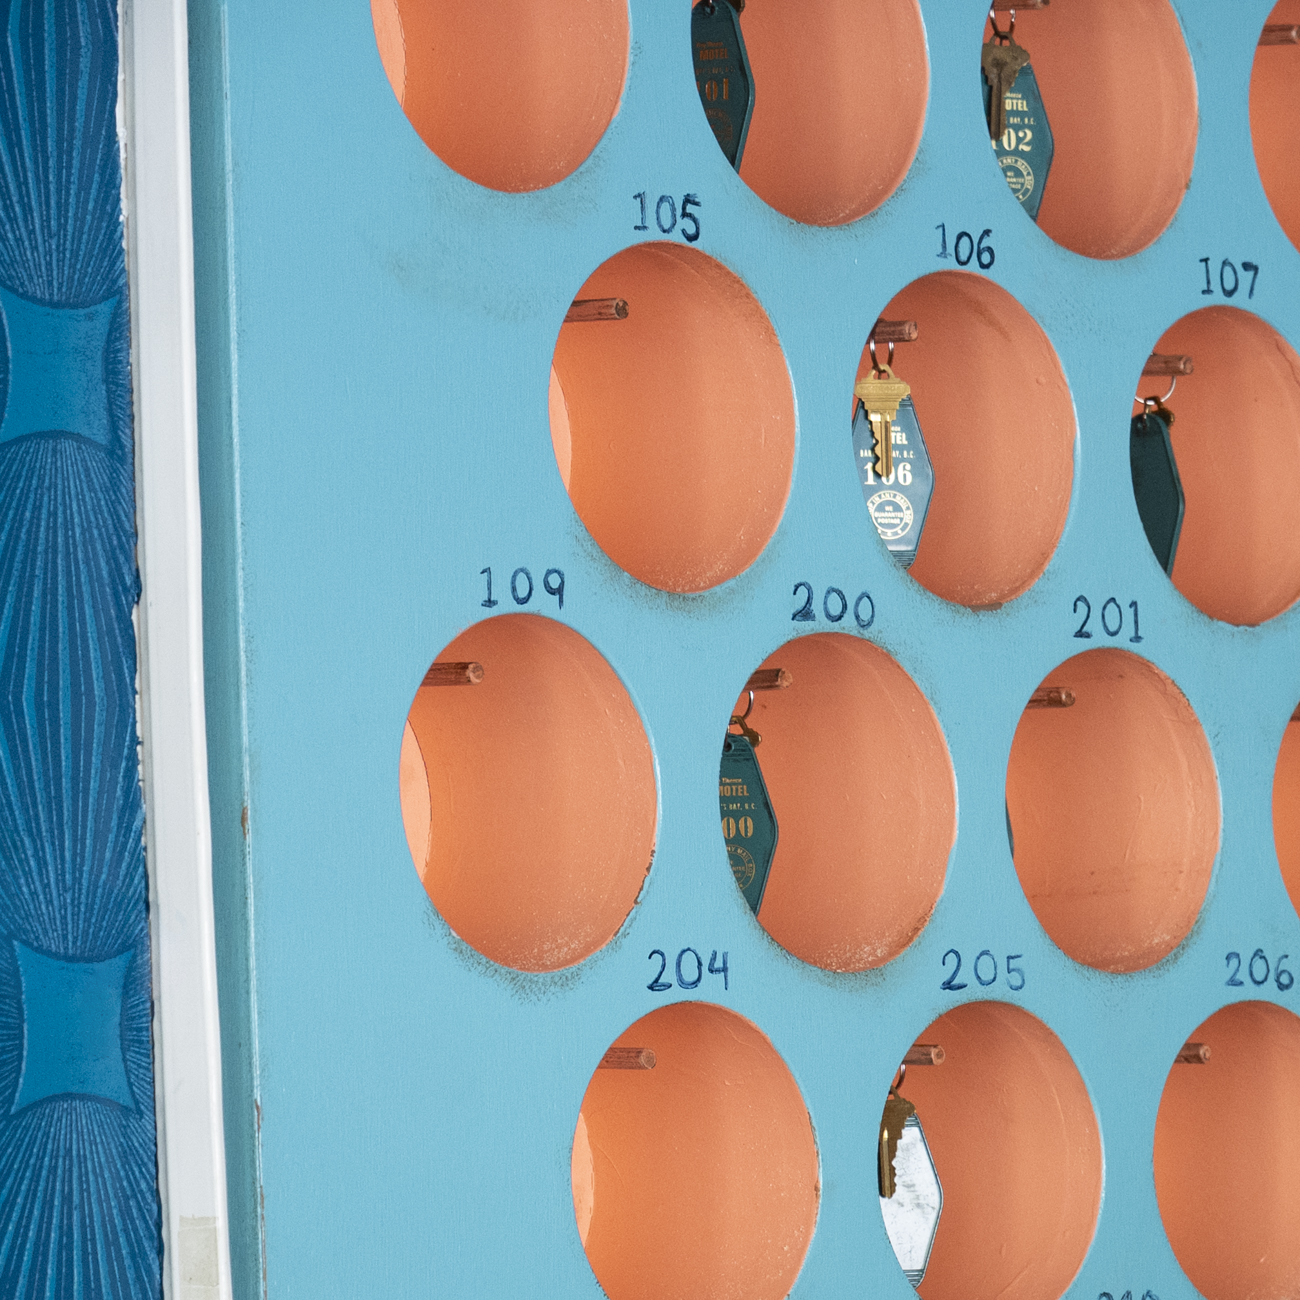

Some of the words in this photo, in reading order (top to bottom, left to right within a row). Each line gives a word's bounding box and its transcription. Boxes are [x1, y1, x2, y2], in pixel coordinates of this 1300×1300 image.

[1005, 99, 1029, 111] OTEL
[632, 192, 703, 244] 105
[935, 224, 997, 271] 106
[1199, 257, 1261, 300] 107
[480, 567, 567, 610] 109
[791, 582, 877, 632] 200
[1072, 595, 1144, 645] 201
[647, 947, 731, 993] 204
[940, 949, 1027, 993] 205
[1224, 949, 1296, 993] 206
